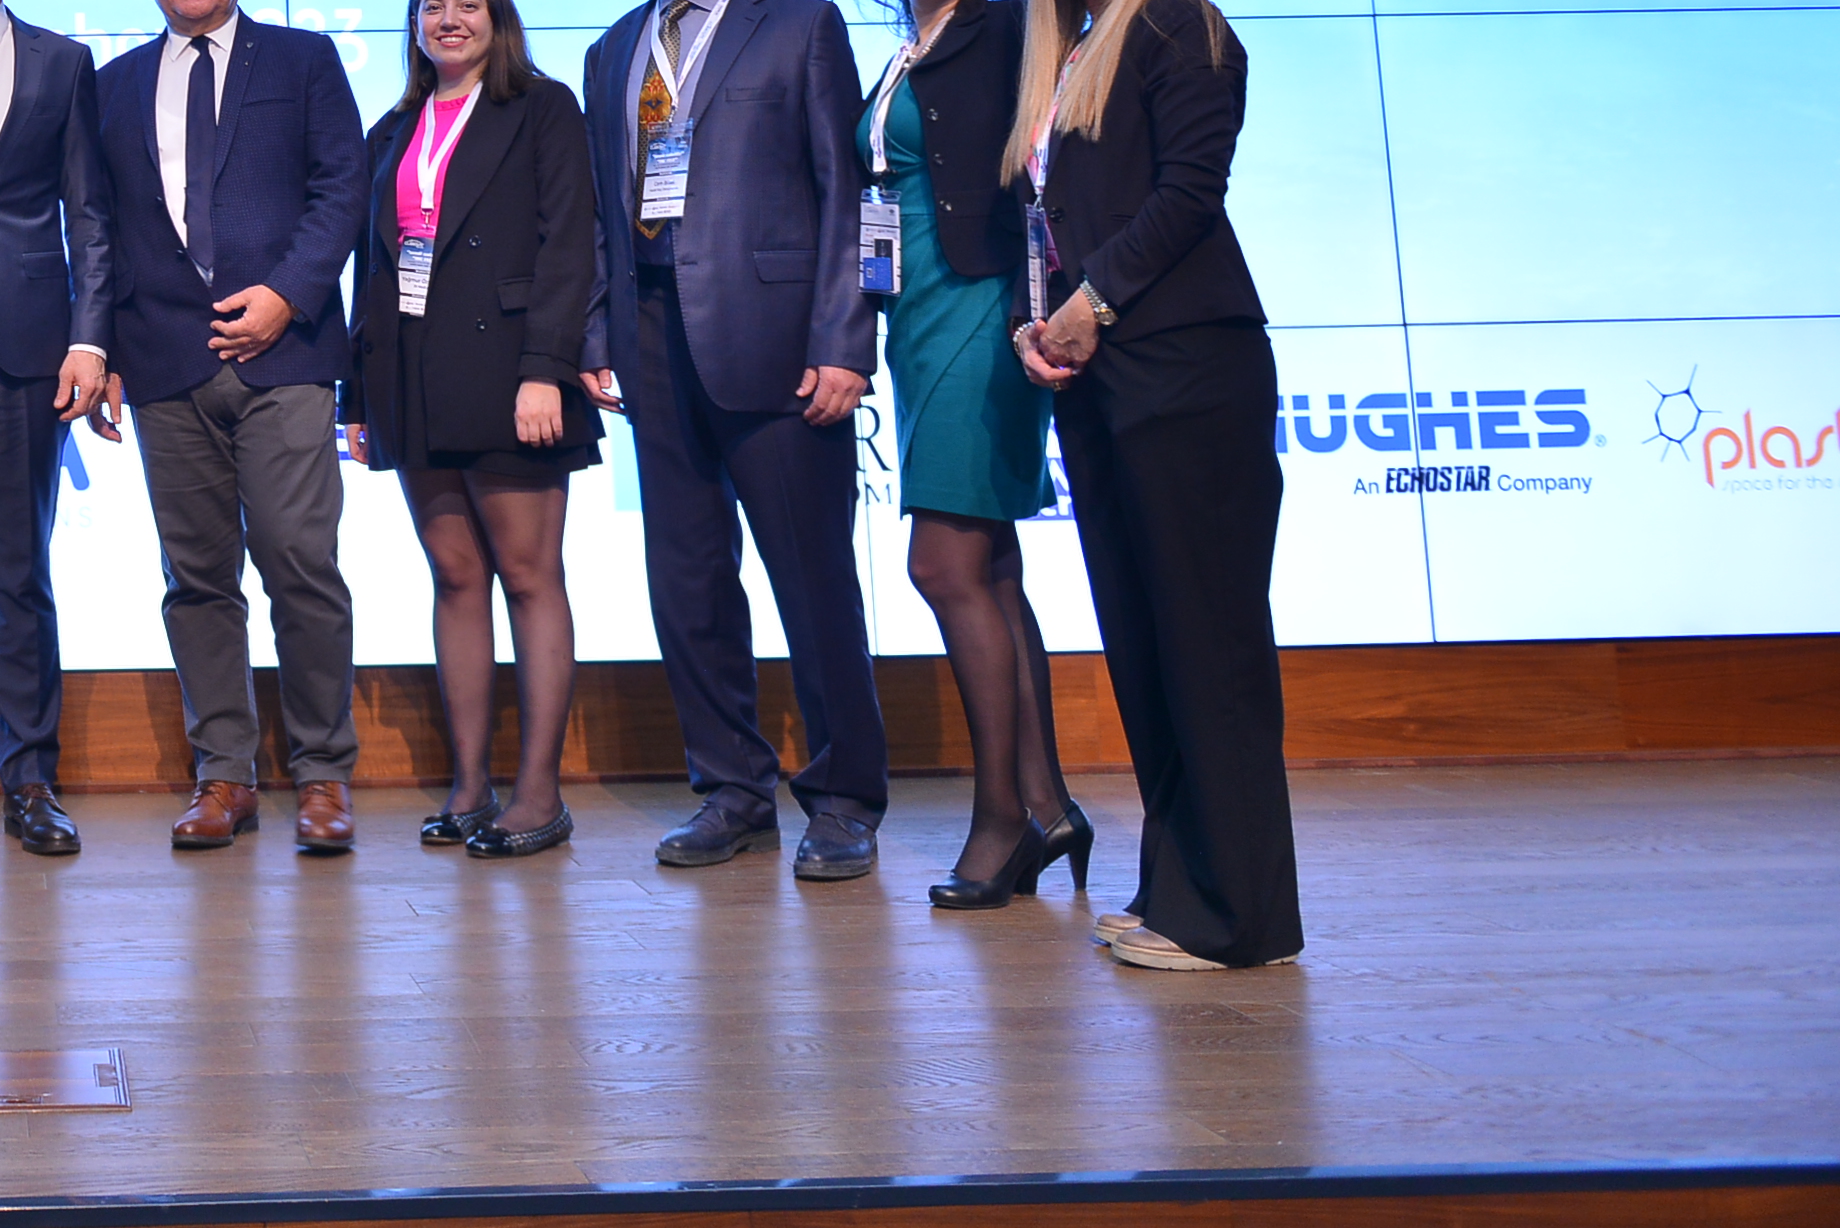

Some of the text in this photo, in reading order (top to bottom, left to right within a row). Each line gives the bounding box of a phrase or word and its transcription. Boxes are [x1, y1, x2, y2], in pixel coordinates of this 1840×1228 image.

[1703, 408, 1840, 490] plas
[1354, 465, 1593, 496] An ECHOSTAR Company
